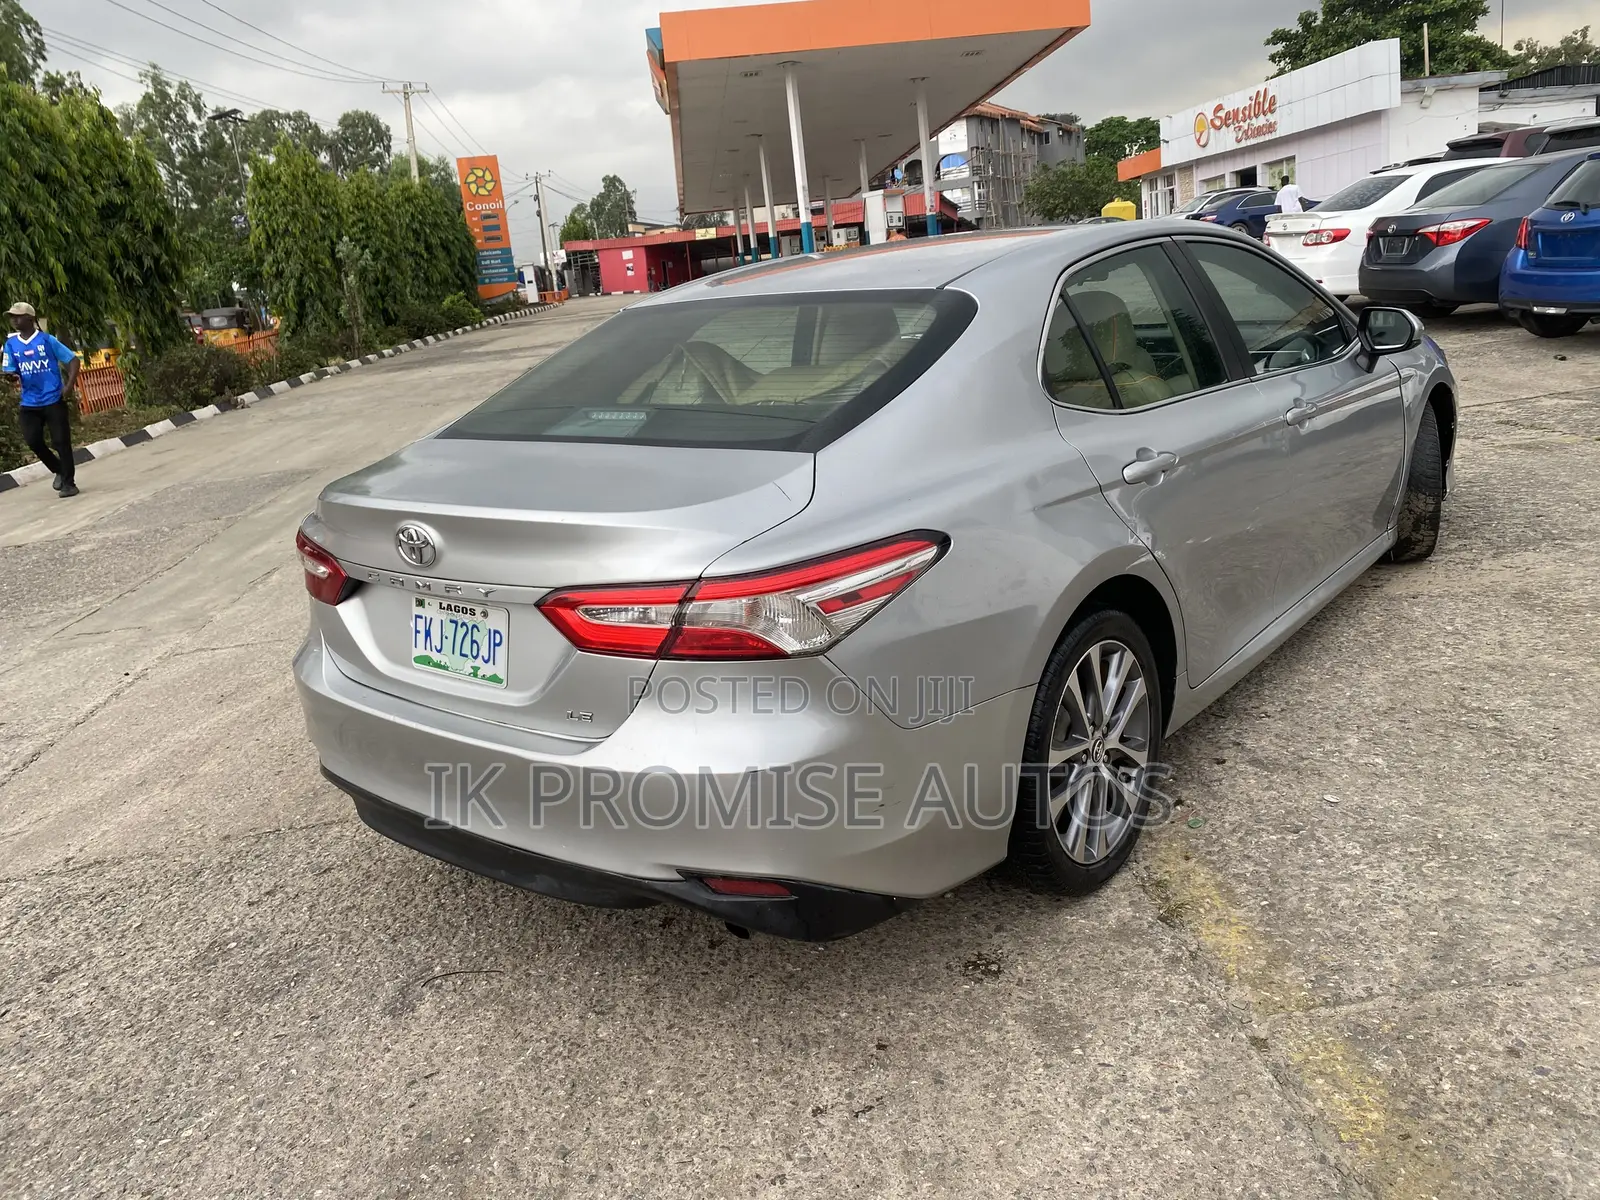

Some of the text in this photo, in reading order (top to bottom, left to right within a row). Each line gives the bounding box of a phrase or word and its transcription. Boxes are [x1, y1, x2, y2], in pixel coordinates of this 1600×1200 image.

[1210, 87, 1277, 130] Sensible
[466, 198, 503, 212] Conoil
[367, 571, 497, 597] CAMRY
[438, 602, 476, 616] LAGOS
[566, 709, 594, 723] LE
